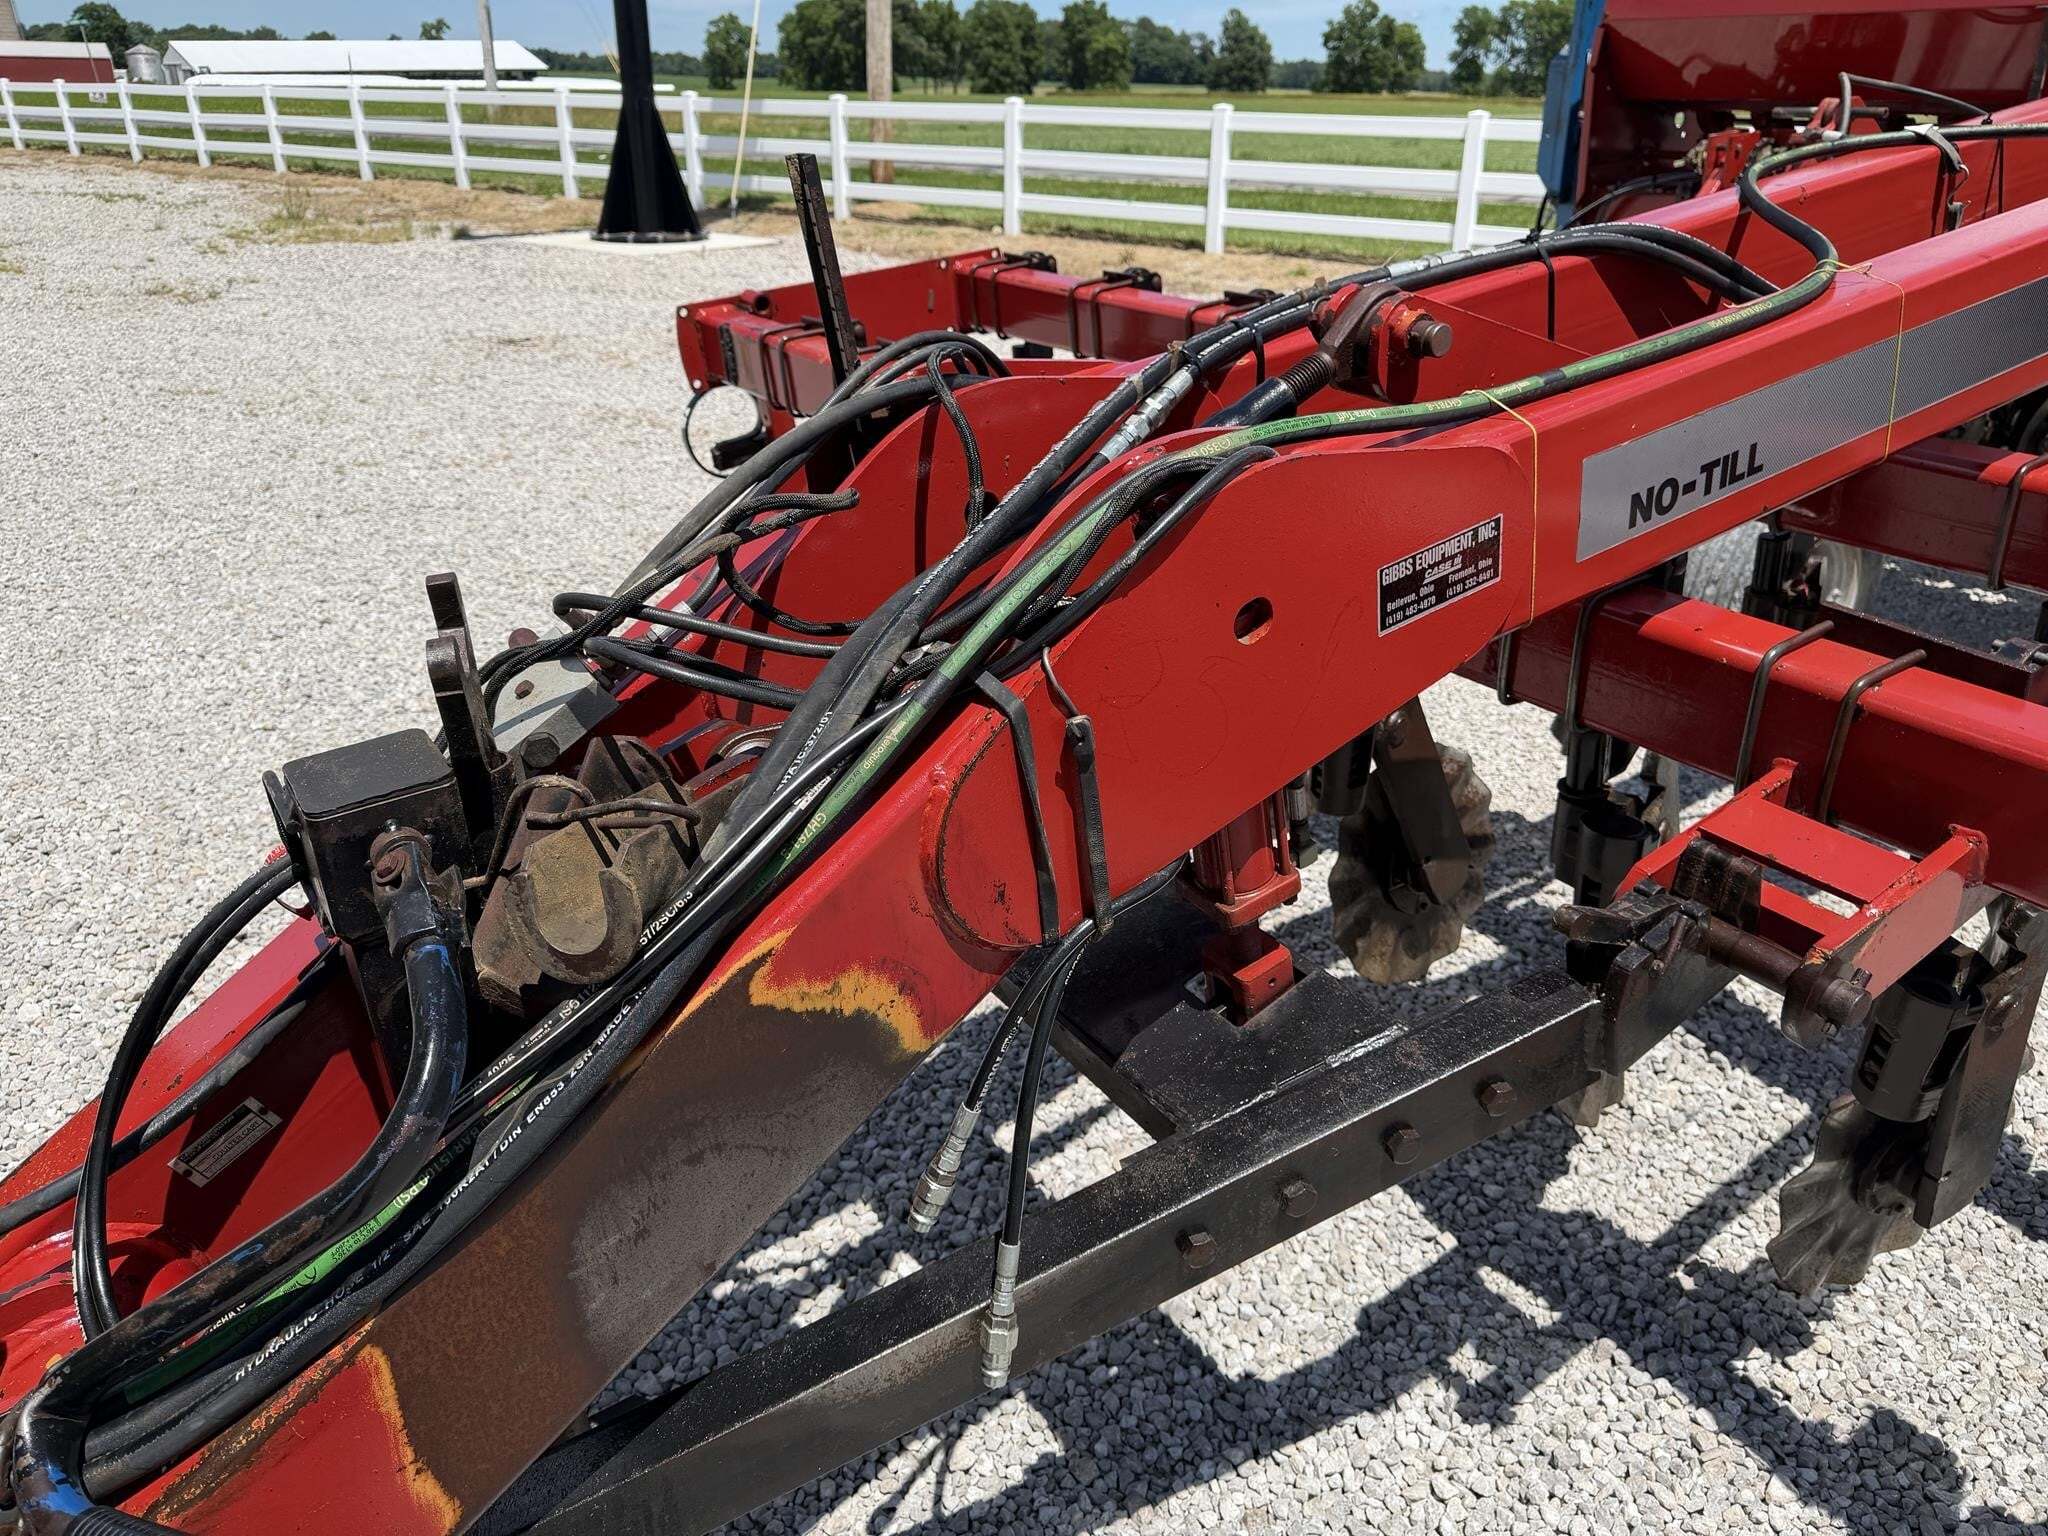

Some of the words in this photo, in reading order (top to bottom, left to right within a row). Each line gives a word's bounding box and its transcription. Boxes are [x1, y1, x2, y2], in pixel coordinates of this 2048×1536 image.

[1628, 442, 1764, 529] NO-TILL
[1382, 558, 1414, 586] GIBBS
[1415, 531, 1476, 571] EQUIPMENT,
[1478, 521, 1498, 543] INC.
[1424, 559, 1452, 578] CASE
[1478, 557, 1493, 570] Ohio
[1386, 592, 1418, 613] Bellevue,
[1419, 583, 1435, 597] Ohio
